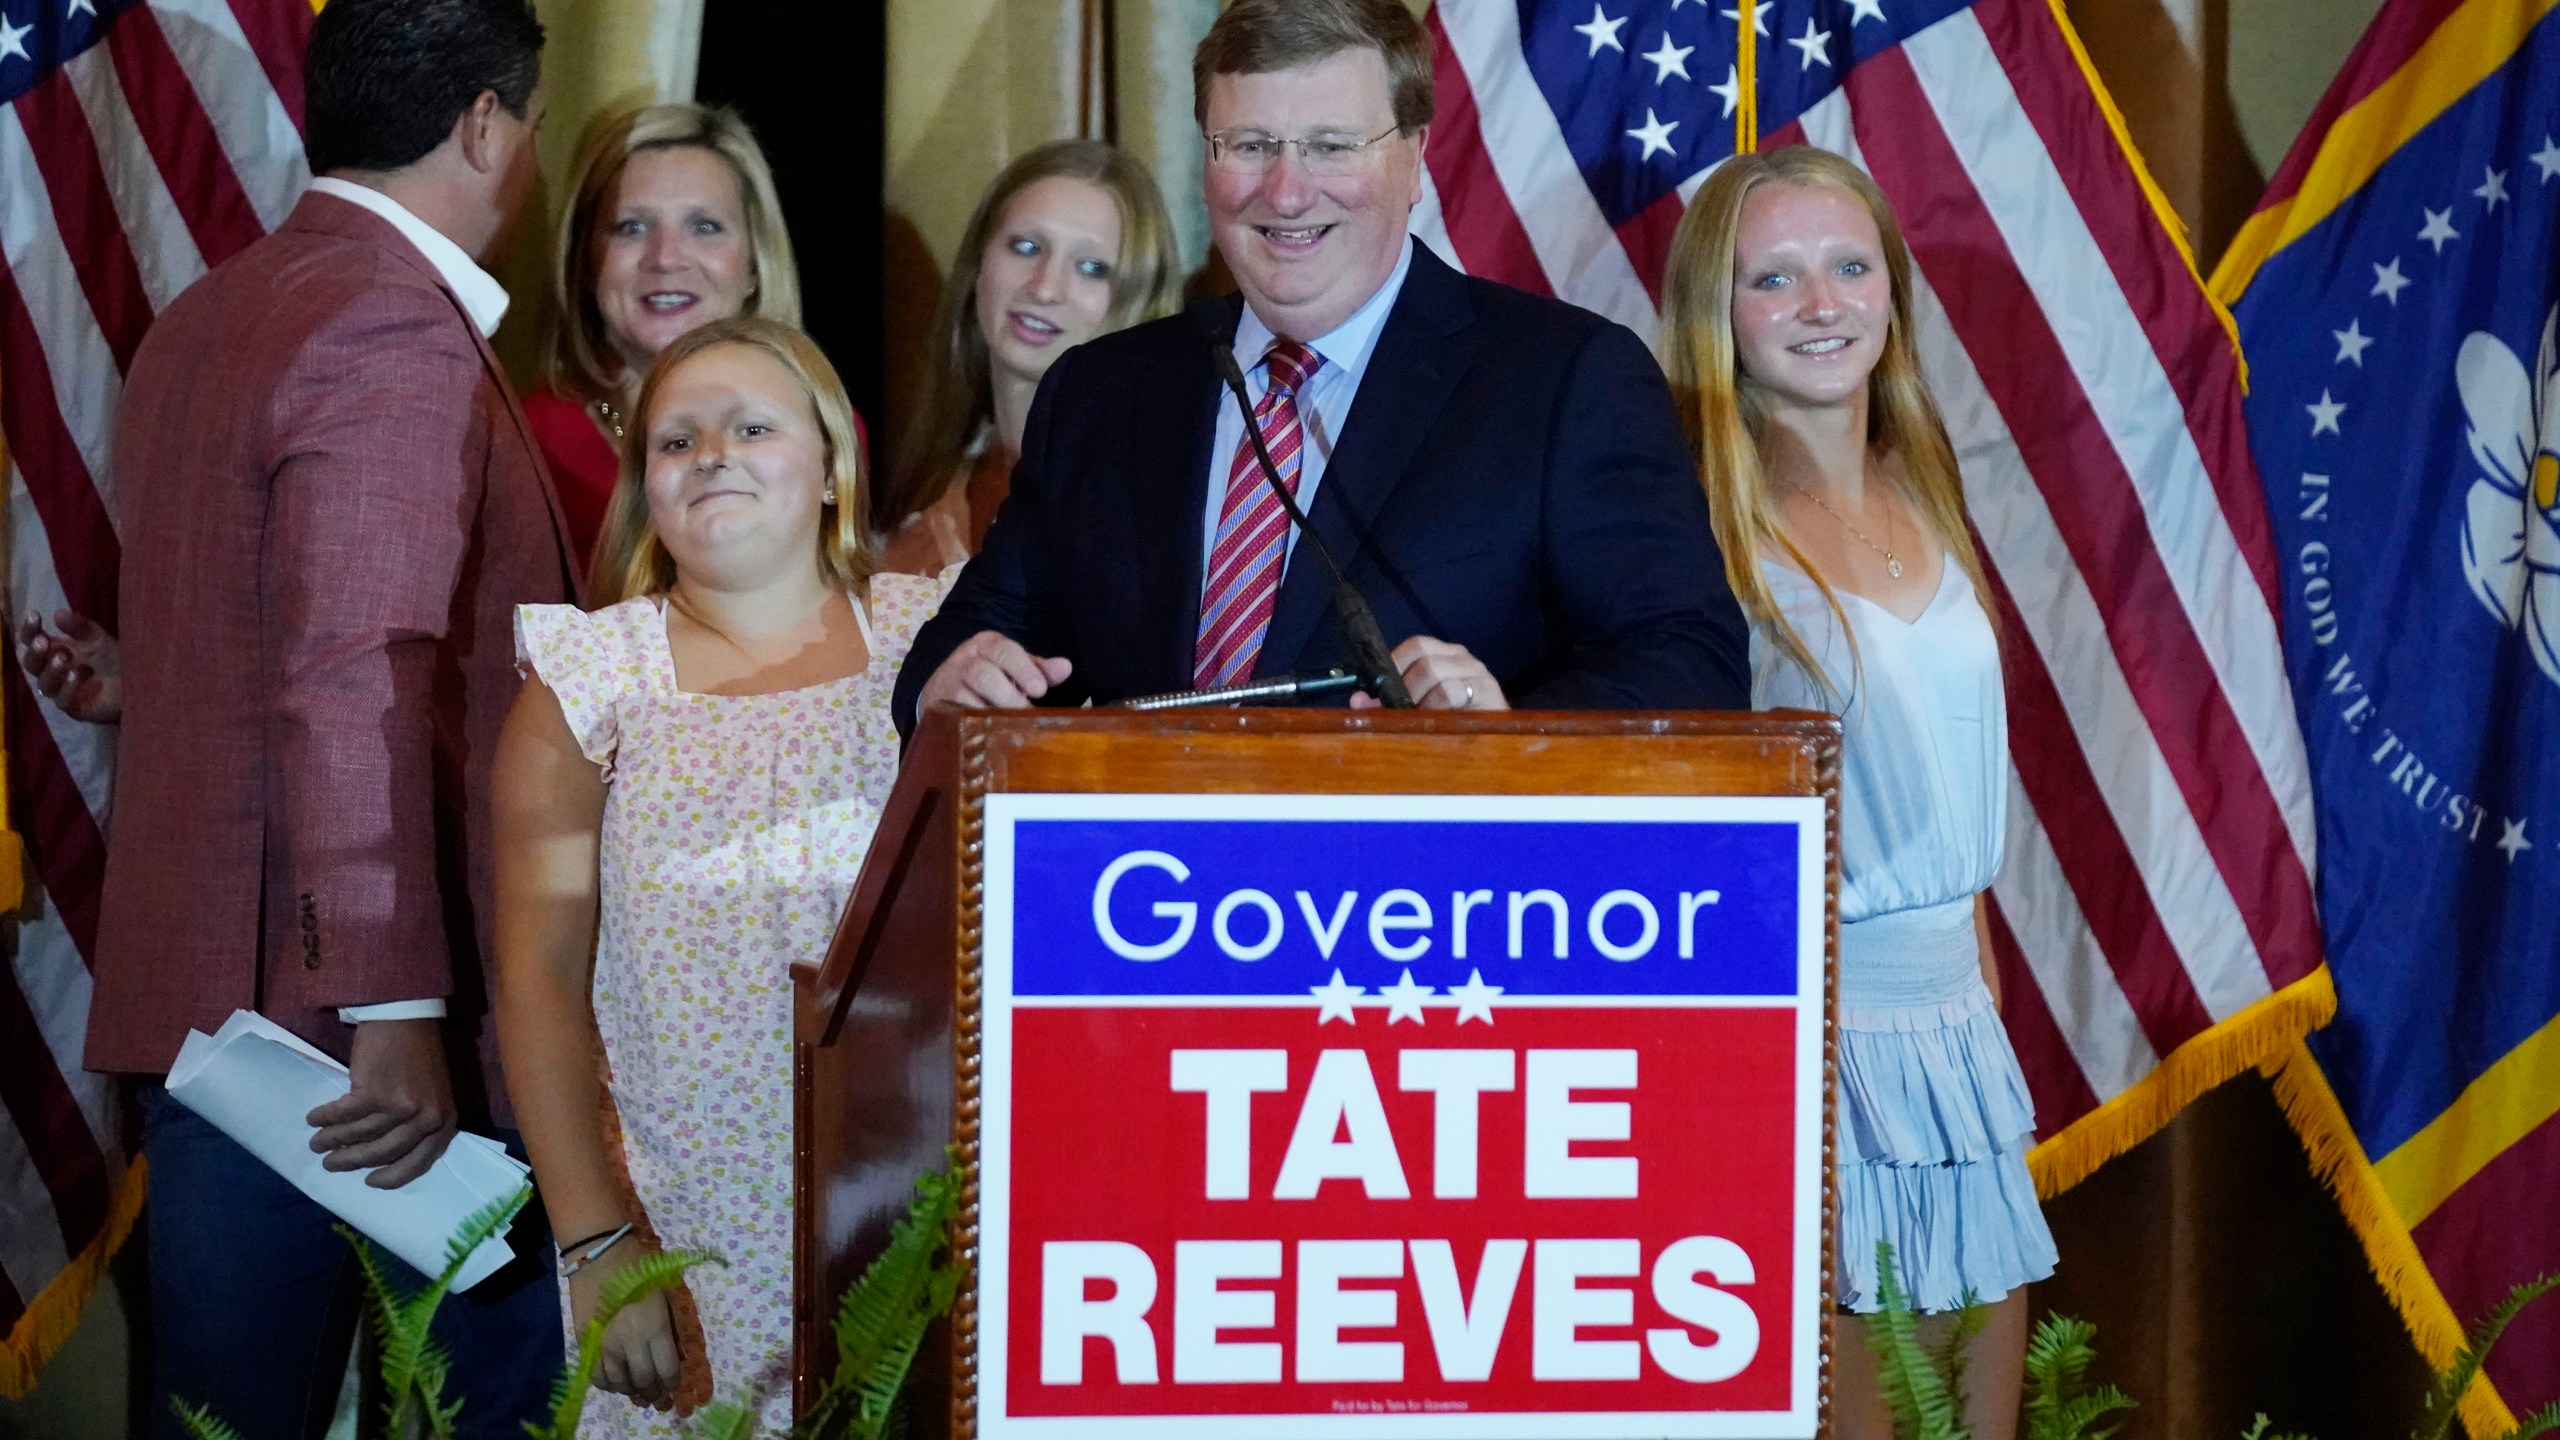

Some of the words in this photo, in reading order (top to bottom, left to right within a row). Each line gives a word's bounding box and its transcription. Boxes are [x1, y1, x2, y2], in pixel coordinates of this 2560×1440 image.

[2299, 472, 2331, 522] IN
[2299, 540, 2339, 647] GOD
[2325, 653, 2377, 735] WE
[2371, 728, 2489, 843] TRUST
[1091, 849, 1721, 962] Governor
[1169, 1048, 1639, 1201] TATE
[1040, 1235, 1761, 1386] REEVES
